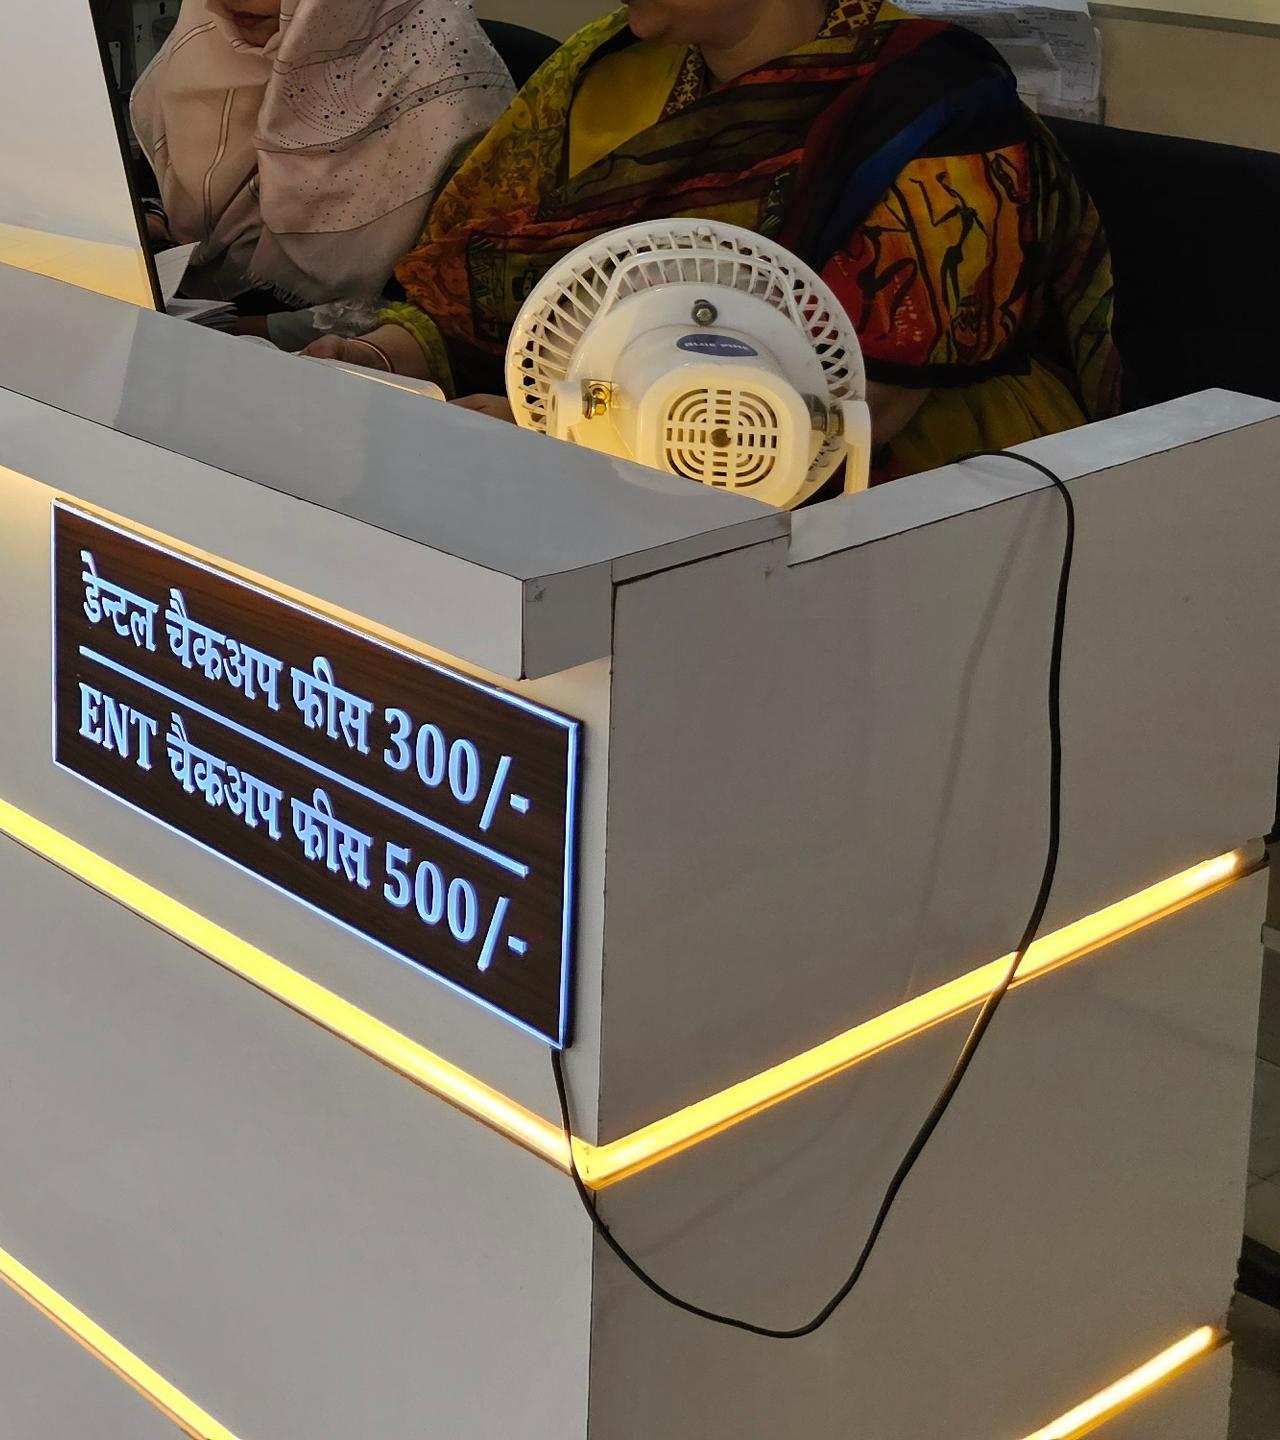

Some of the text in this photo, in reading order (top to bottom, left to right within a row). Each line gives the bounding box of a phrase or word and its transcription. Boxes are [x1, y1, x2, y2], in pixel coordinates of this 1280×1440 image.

[78, 682, 528, 972] ENT चैकअप फीस 500/-
[166, 588, 283, 712] चैकअप
[290, 656, 374, 755] फीस
[384, 707, 530, 832] 300/-
